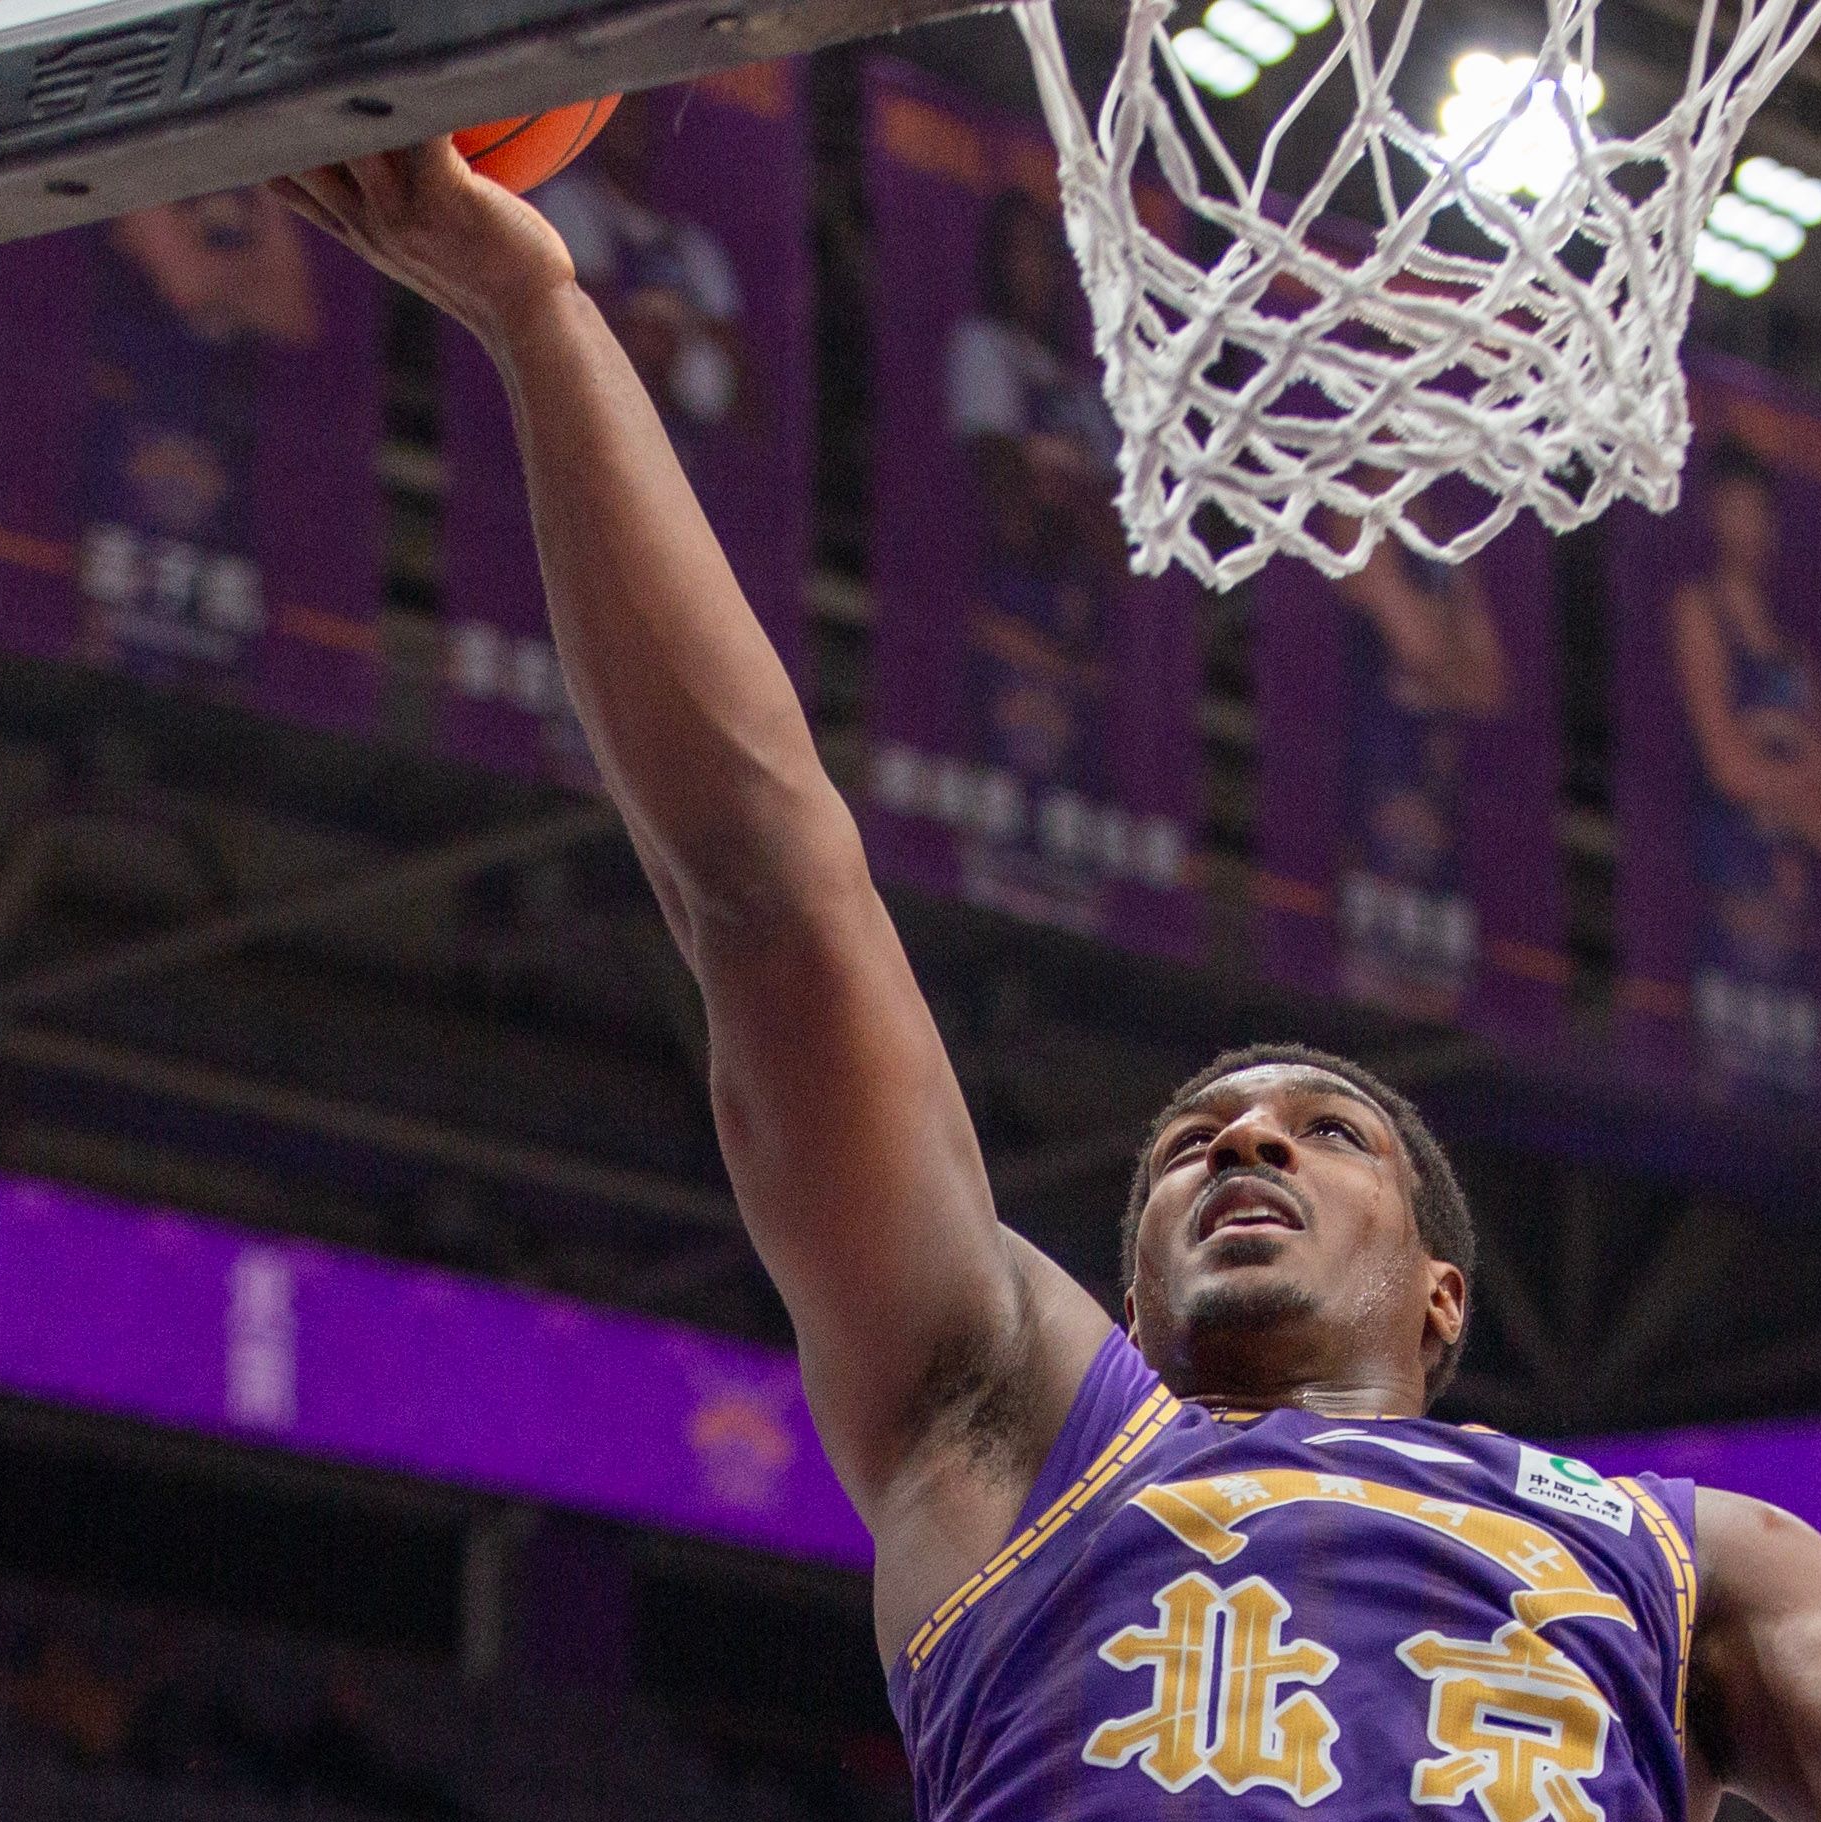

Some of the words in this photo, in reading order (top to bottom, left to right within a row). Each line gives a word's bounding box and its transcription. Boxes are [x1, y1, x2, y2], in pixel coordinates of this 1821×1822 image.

[1527, 1486, 1581, 1507] CHINA
[1586, 1503, 1622, 1523] LIFE
[1529, 1472, 1624, 1514] 中国人寿
